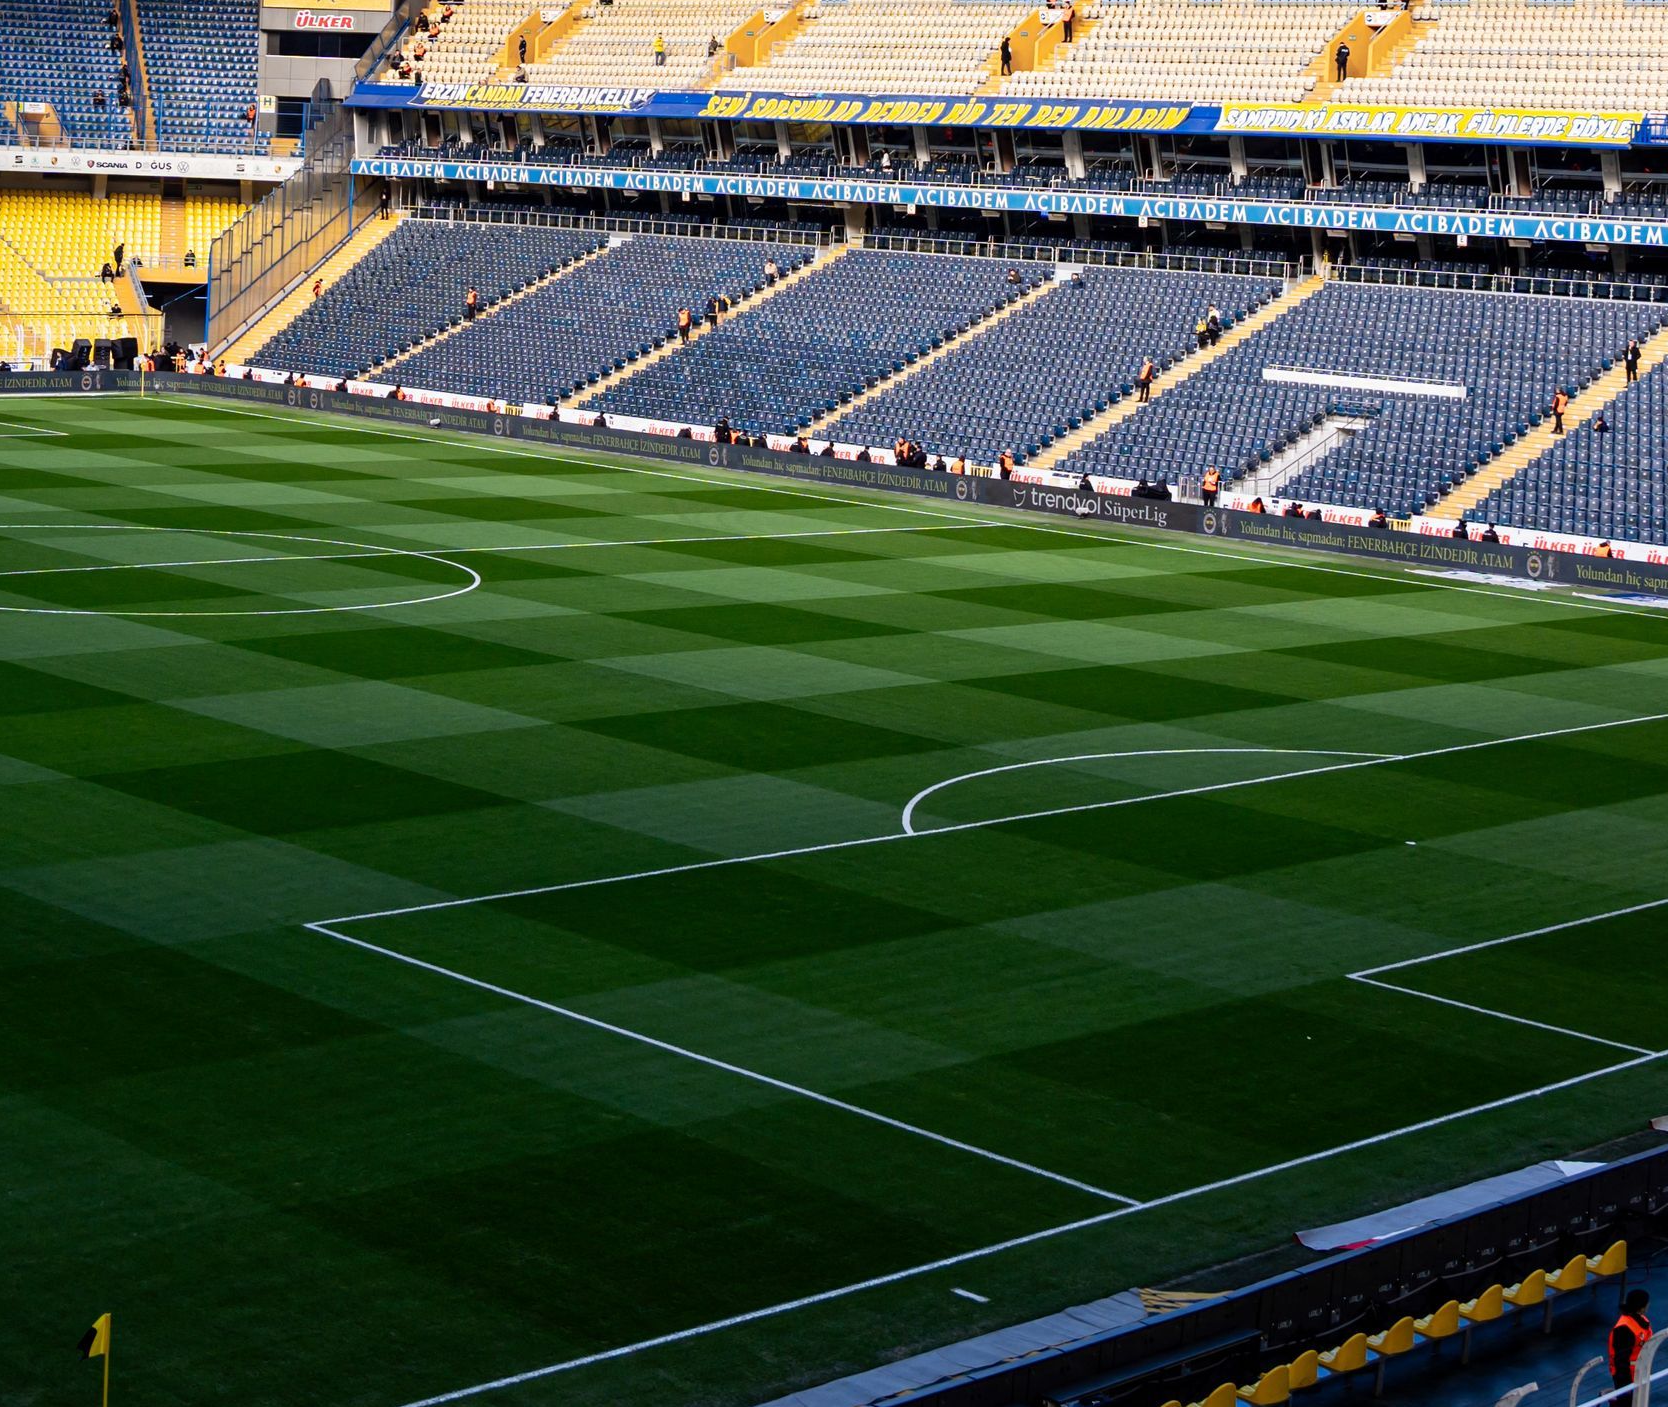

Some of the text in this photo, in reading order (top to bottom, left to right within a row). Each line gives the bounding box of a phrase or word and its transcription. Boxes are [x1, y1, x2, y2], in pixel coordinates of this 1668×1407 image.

[295, 11, 353, 29] ÜLKER
[263, 97, 272, 106] H
[699, 92, 752, 117] SENİ
[744, 98, 863, 121] SORSUNLAR
[856, 101, 945, 122] BENDEN
[940, 97, 987, 124] BİR
[1027, 105, 1080, 127] BEN
[1072, 106, 1190, 129] ANLARIM
[1396, 112, 1464, 134] ANCAK
[96, 161, 128, 170] SCANIA
[358, 160, 445, 178] ACIBADEM
[455, 166, 529, 183] ACIBADEM
[539, 170, 614, 188] ACIBADEM
[625, 174, 703, 192] ACIBADEM
[715, 180, 800, 197] ACIBADEM
[812, 184, 900, 202] ACIBADEM
[914, 189, 1008, 208] ACIBADEM
[1025, 195, 1124, 214] ACIBADEM
[1140, 200, 1248, 221] ACIBADEM
[1264, 207, 1377, 228] ACIBADEM
[1395, 213, 1515, 236] ACIBADEM
[1534, 220, 1663, 244] ACIBADEM
[742, 454, 948, 493] Yolundan hiç sapmadan; FENERBAHÇE İZİNDEDİR ATAM
[1009, 470, 1043, 485] ÜLKER
[1097, 481, 1131, 497] ÜLKER
[1031, 487, 1168, 527] trendyol SüperLig
[1324, 510, 1362, 527] ÜLKER
[1240, 520, 1513, 569] Yolundan hiç sapmadan; FENERBAHÇE İZİNDEDİR ATAM
[1534, 536, 1576, 554] ÜLKER
[1576, 564, 1622, 583] Yolundan
[1626, 569, 1641, 588] hiç
